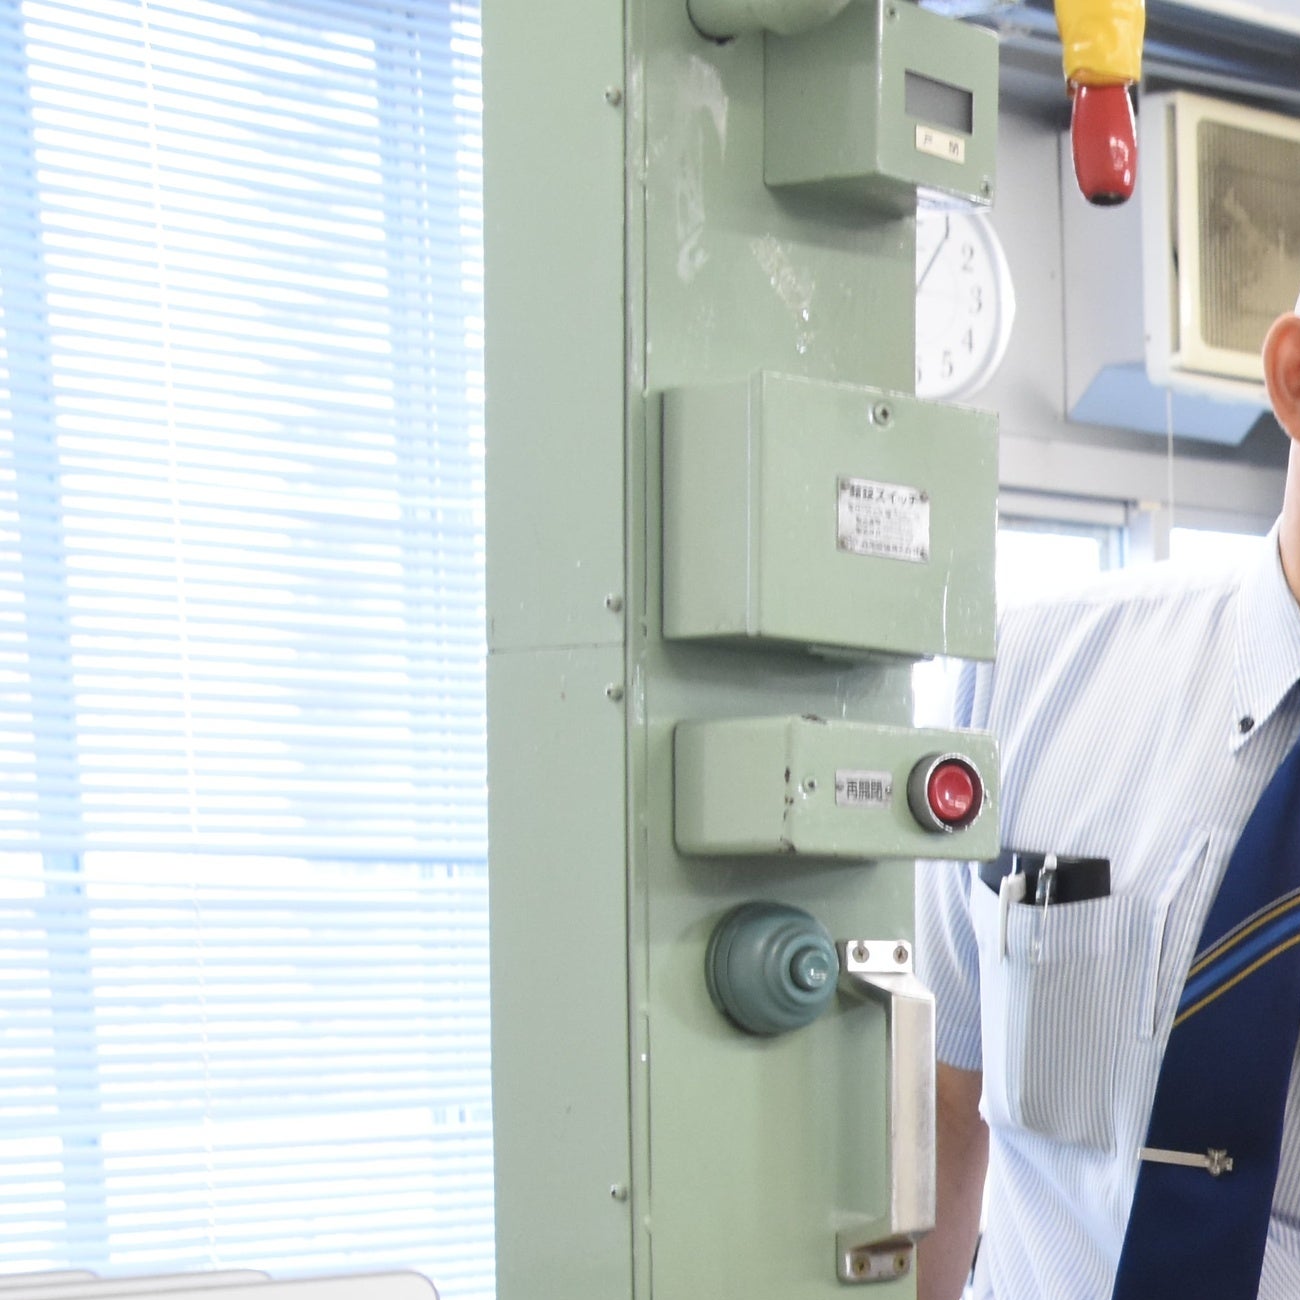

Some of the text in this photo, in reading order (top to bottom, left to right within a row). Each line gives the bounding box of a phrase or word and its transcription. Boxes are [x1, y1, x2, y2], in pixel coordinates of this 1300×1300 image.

[962, 243, 975, 272] 2
[969, 285, 983, 314] 3
[962, 328, 973, 355] 4
[941, 351, 954, 378] 5
